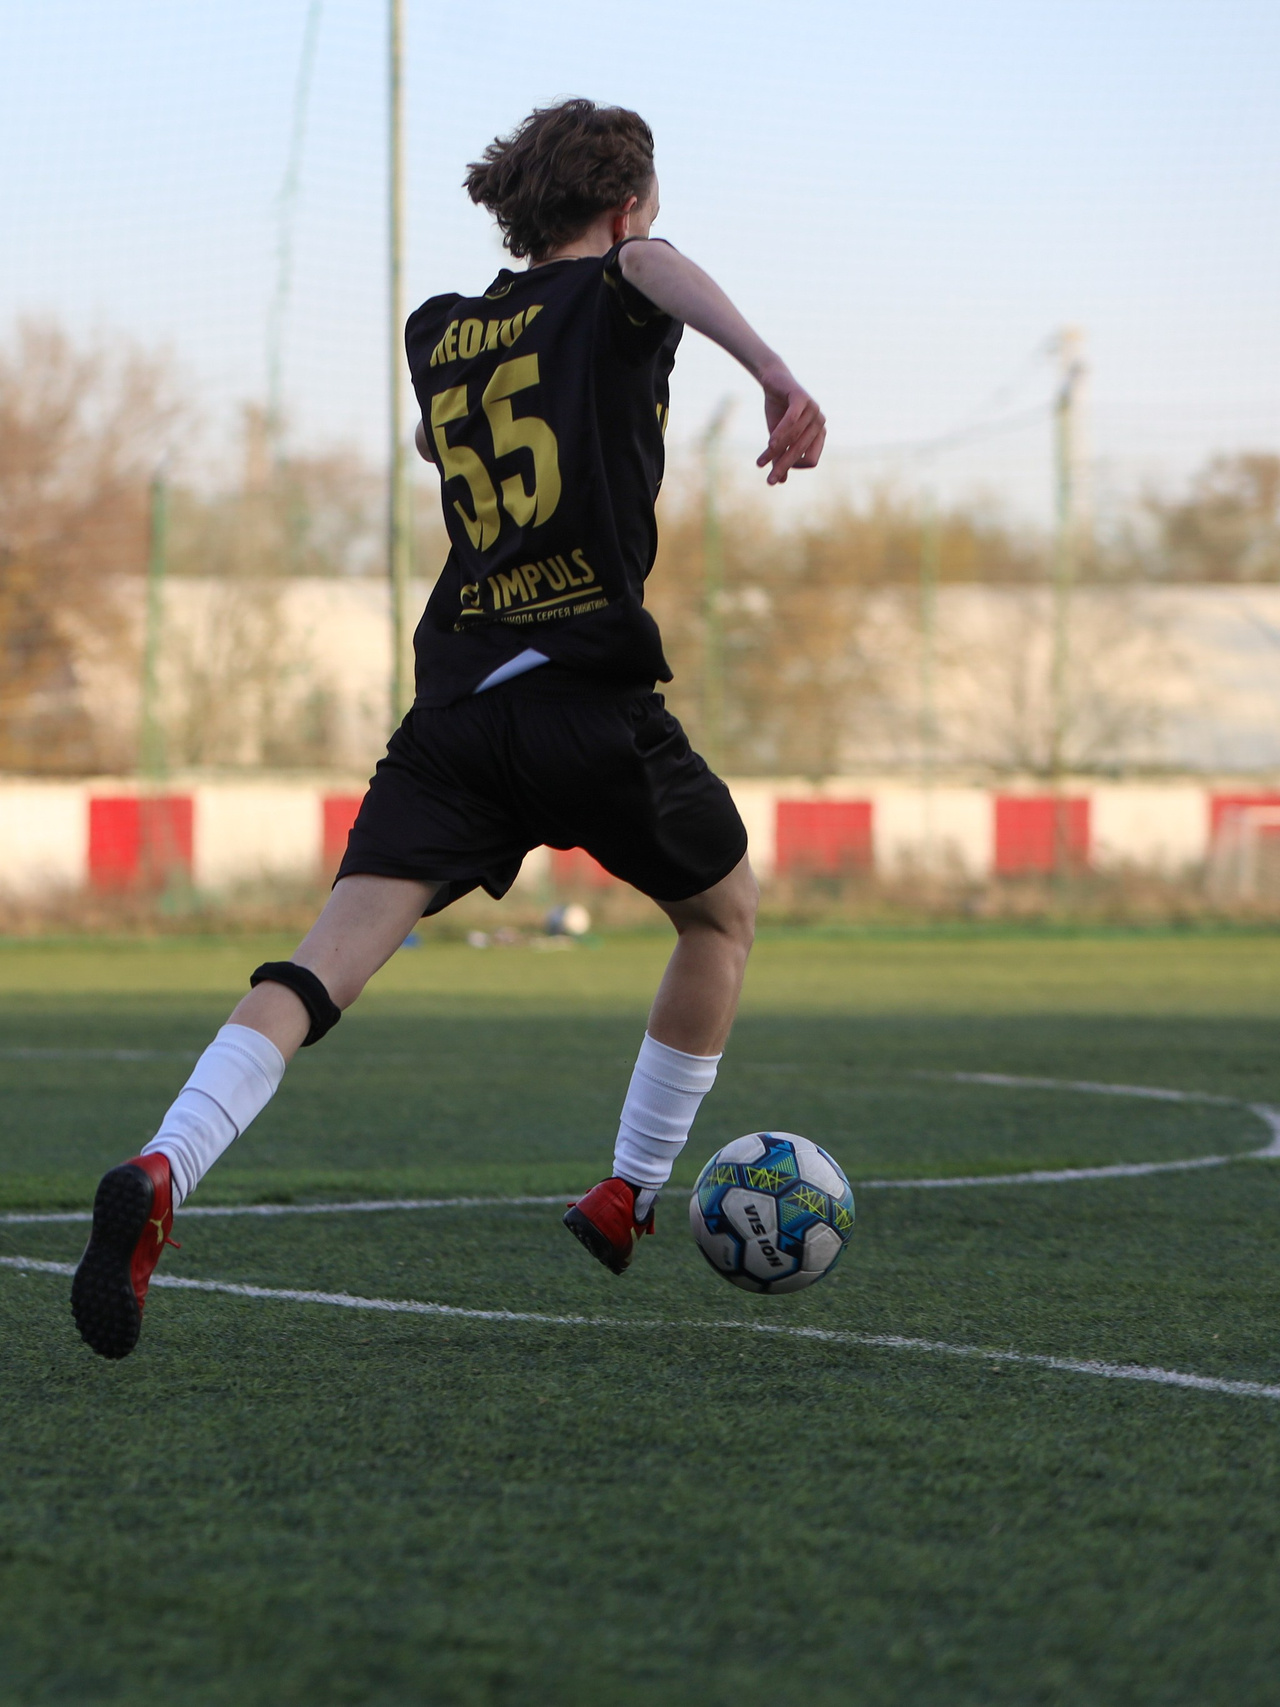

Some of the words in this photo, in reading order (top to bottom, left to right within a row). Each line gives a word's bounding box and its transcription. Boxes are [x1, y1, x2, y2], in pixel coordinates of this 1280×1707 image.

[430, 352, 562, 553] 55
[487, 548, 596, 611] IMPULS
[536, 606, 571, 622] СЕРГЕЯ
[573, 597, 610, 615] НИКИТИНА
[743, 1203, 784, 1268] VISION
